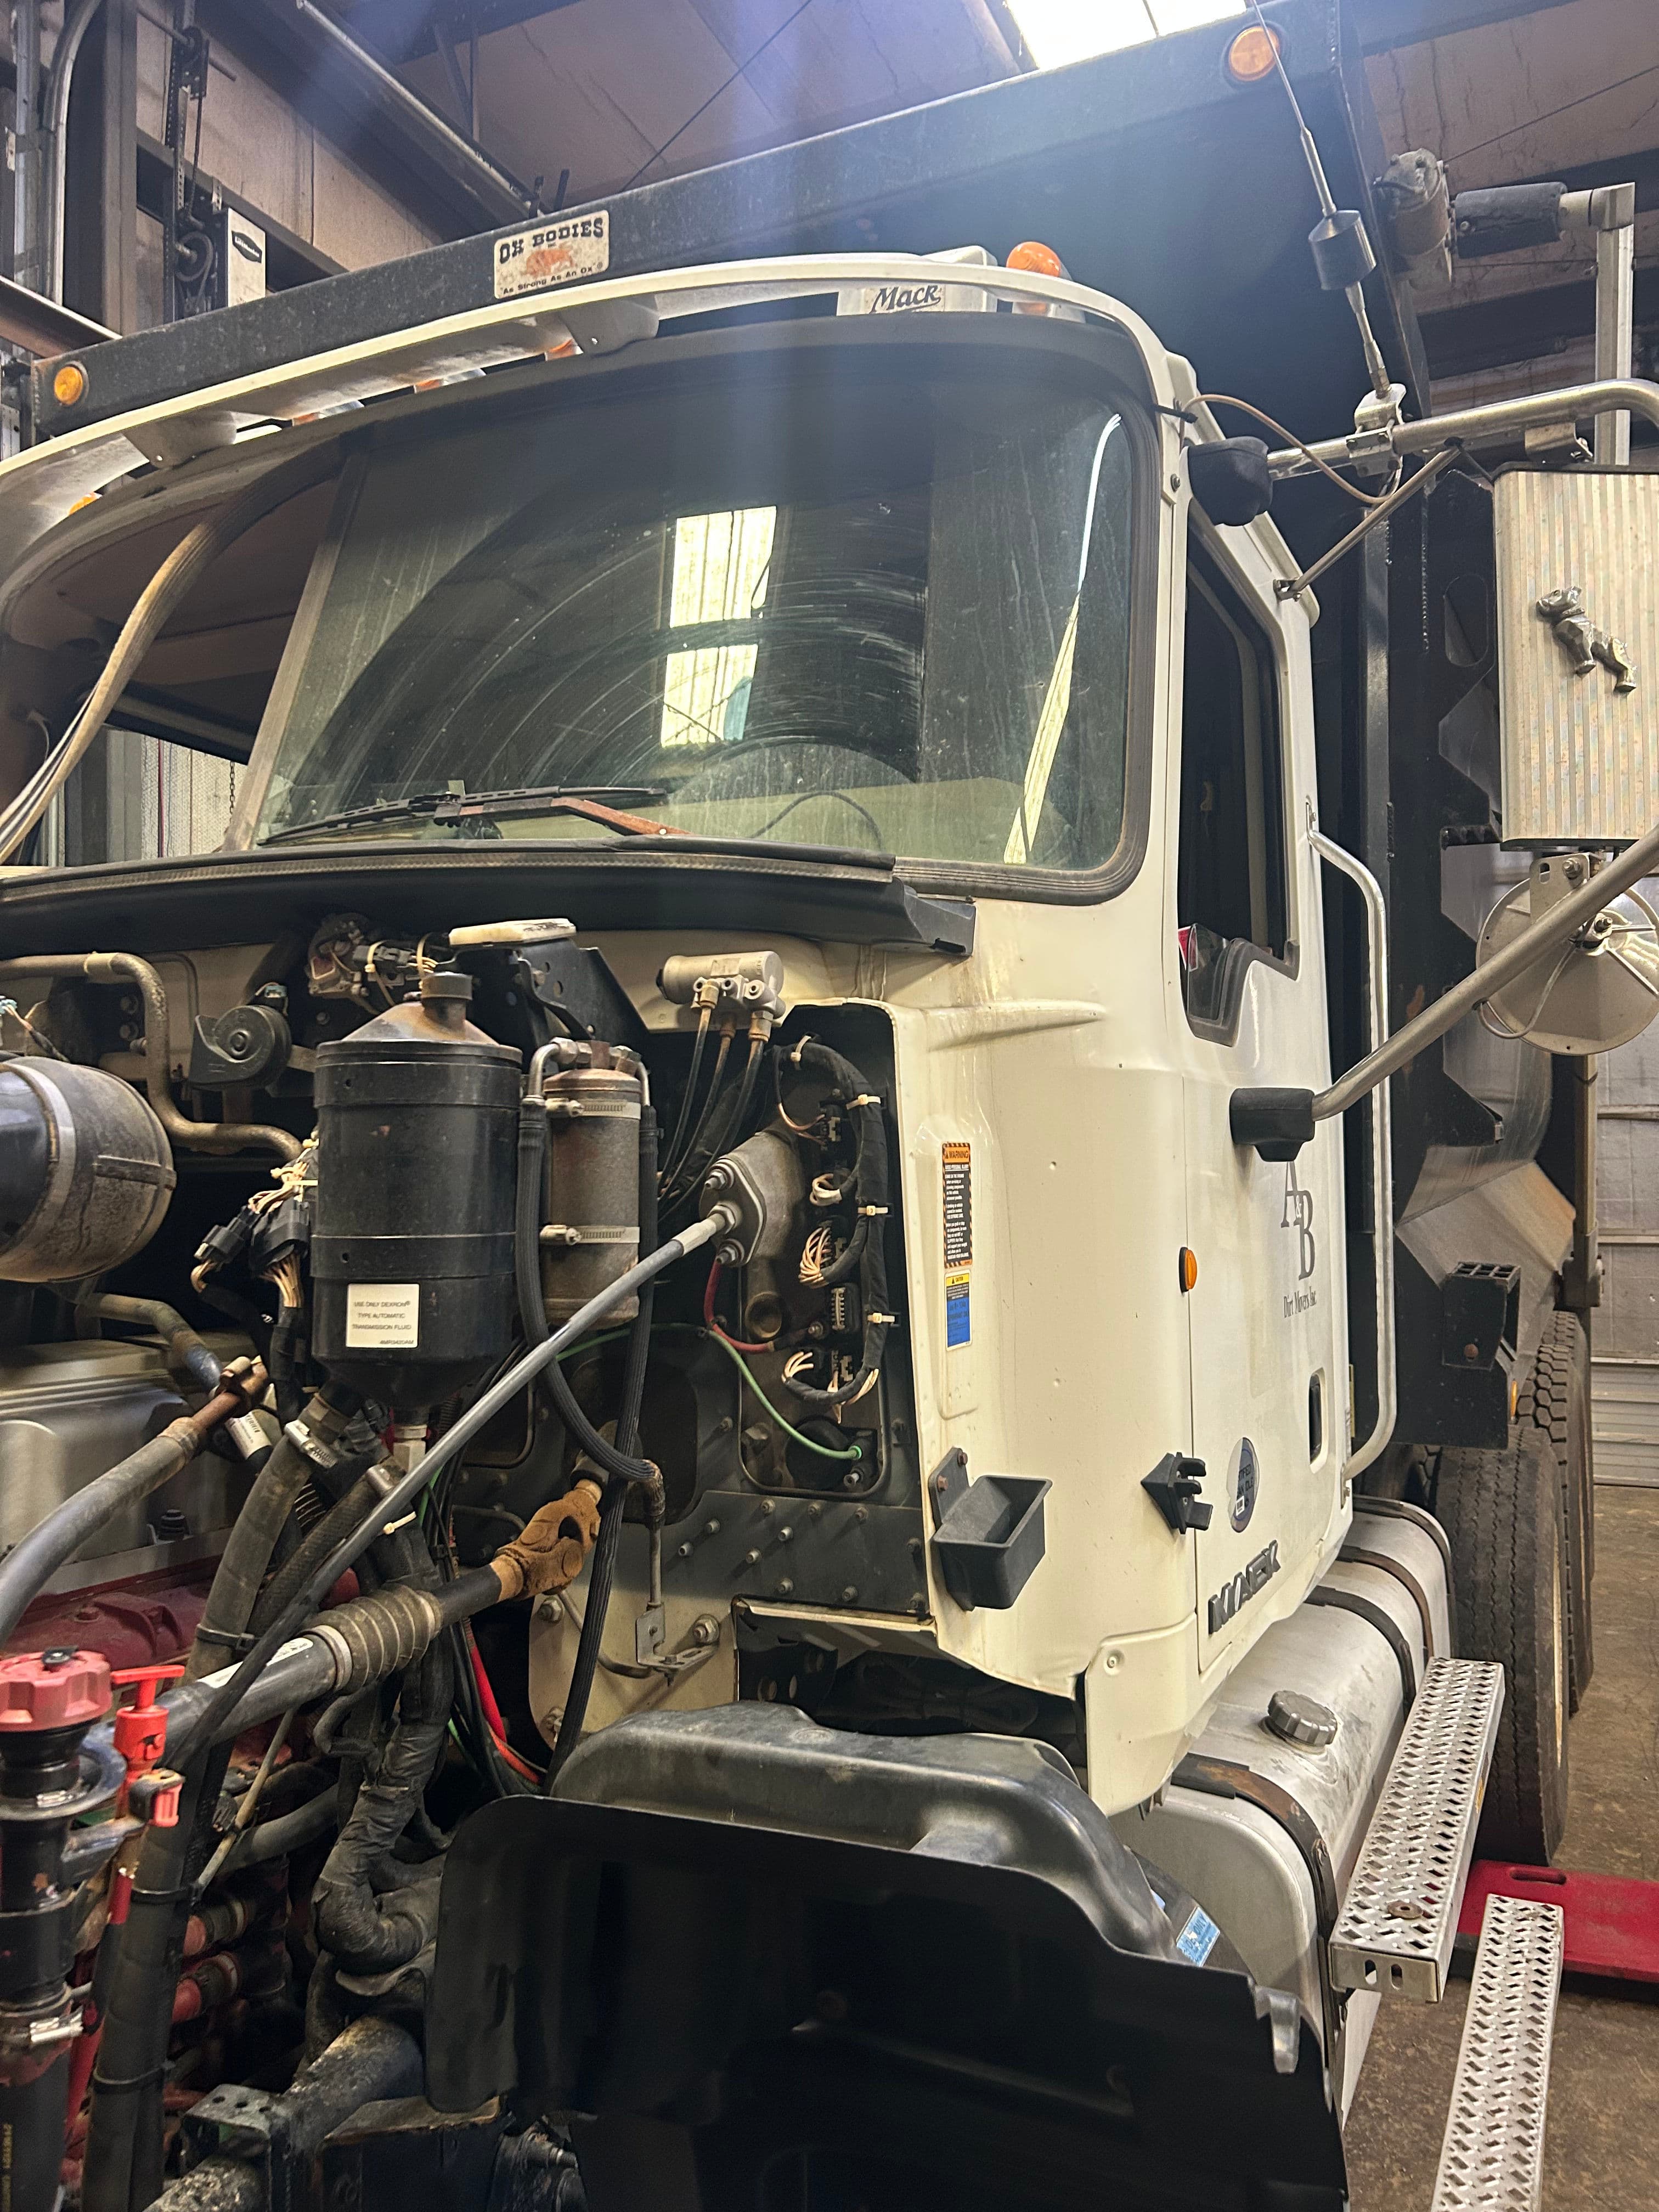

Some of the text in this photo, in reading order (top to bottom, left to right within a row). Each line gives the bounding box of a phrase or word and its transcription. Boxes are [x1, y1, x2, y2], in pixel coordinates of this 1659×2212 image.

[500, 218, 603, 264] OX BODIES
[517, 279, 547, 291] Strong
[949, 1150, 969, 1159] WARNING
[1284, 1295, 1294, 1318] Dirt
[1294, 1290, 1310, 1314] Movers
[1208, 1539, 1282, 1635] MACK
